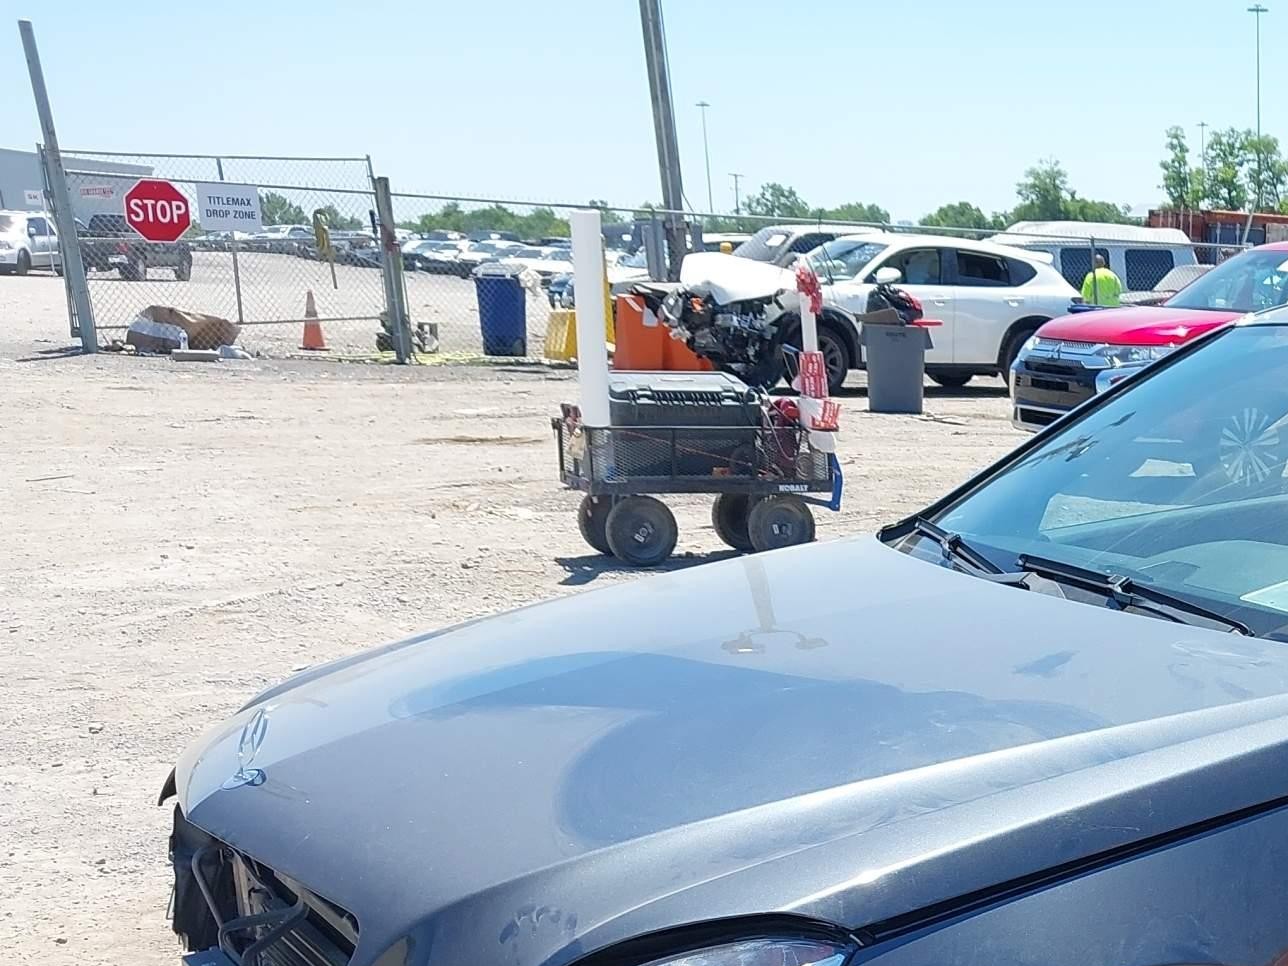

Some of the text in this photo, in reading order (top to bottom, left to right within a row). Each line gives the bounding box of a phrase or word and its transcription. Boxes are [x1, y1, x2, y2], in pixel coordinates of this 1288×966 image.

[207, 195, 252, 207] TITLEMAX
[130, 199, 186, 224] STOP
[205, 208, 256, 220] DROP ZONE
